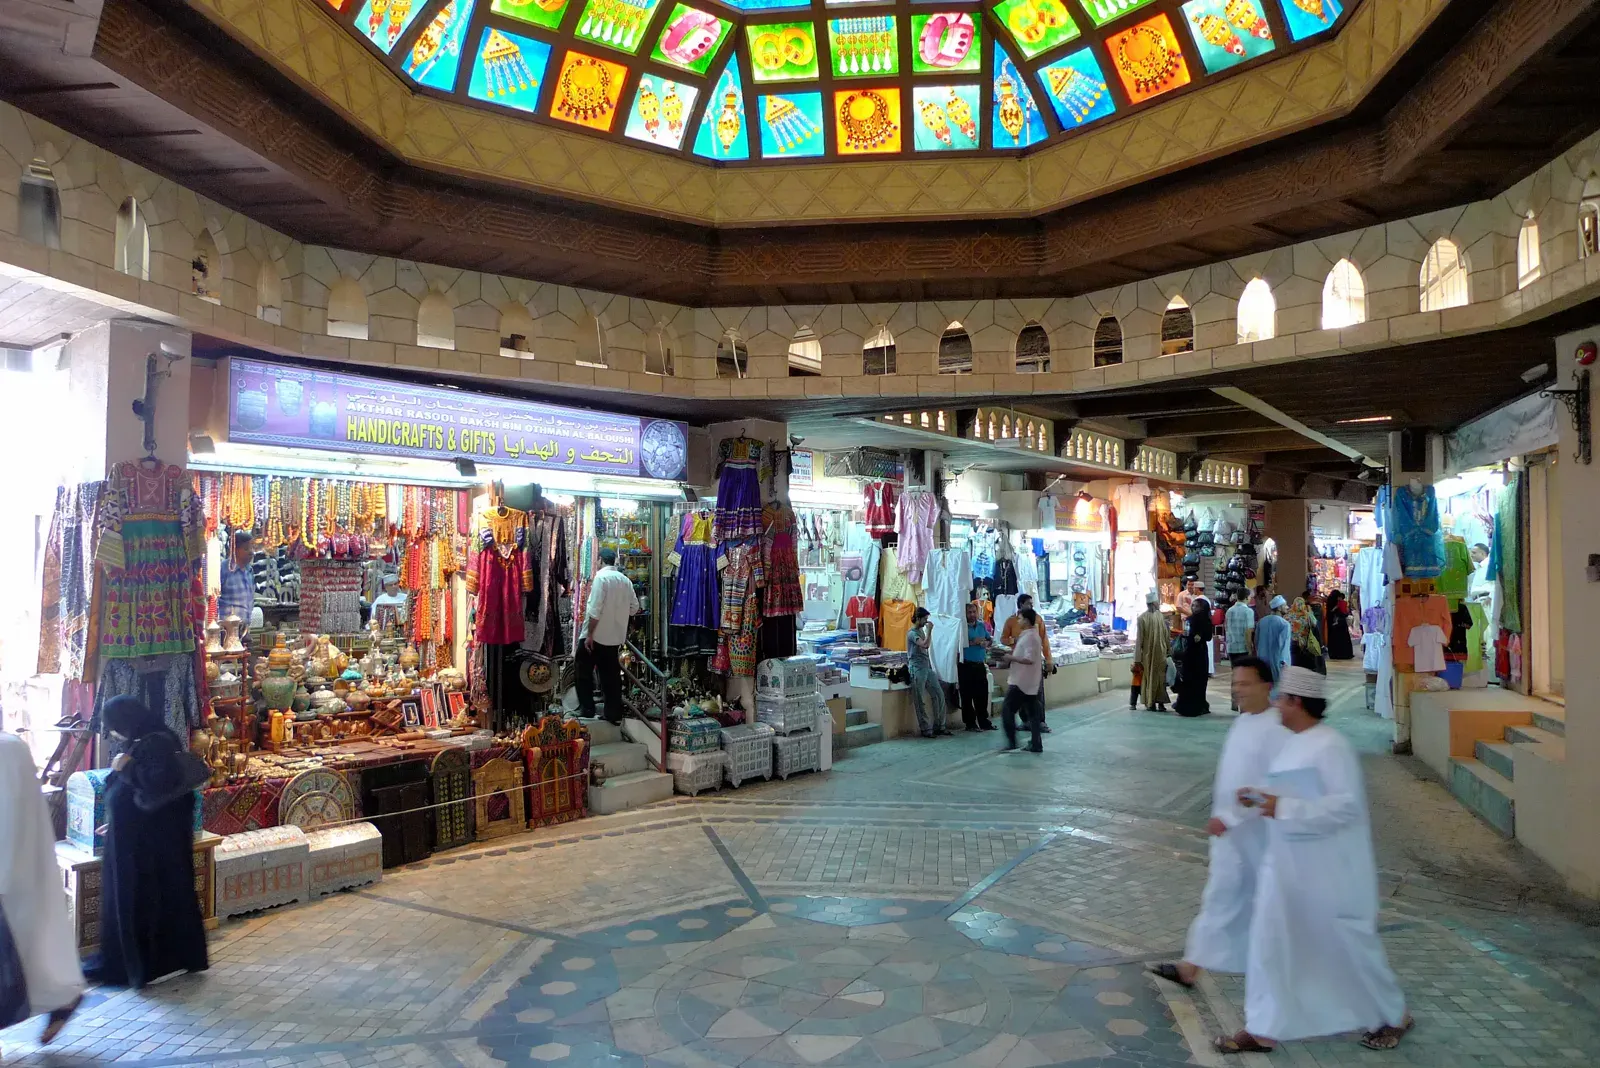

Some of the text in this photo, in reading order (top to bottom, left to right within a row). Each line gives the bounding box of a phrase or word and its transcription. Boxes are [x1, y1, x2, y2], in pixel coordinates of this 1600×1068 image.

[346, 390, 421, 406] البلوشي
[424, 401, 479, 414] عثمان
[346, 402, 634, 445] AKTHAR RASOOL BAKSH BIN OTHMAN AL-BALOUSHI
[545, 415, 581, 429] رسول
[347, 415, 496, 457] HANDICRAFTS & GIFTS
[503, 433, 634, 465] التحف و الهدايا
